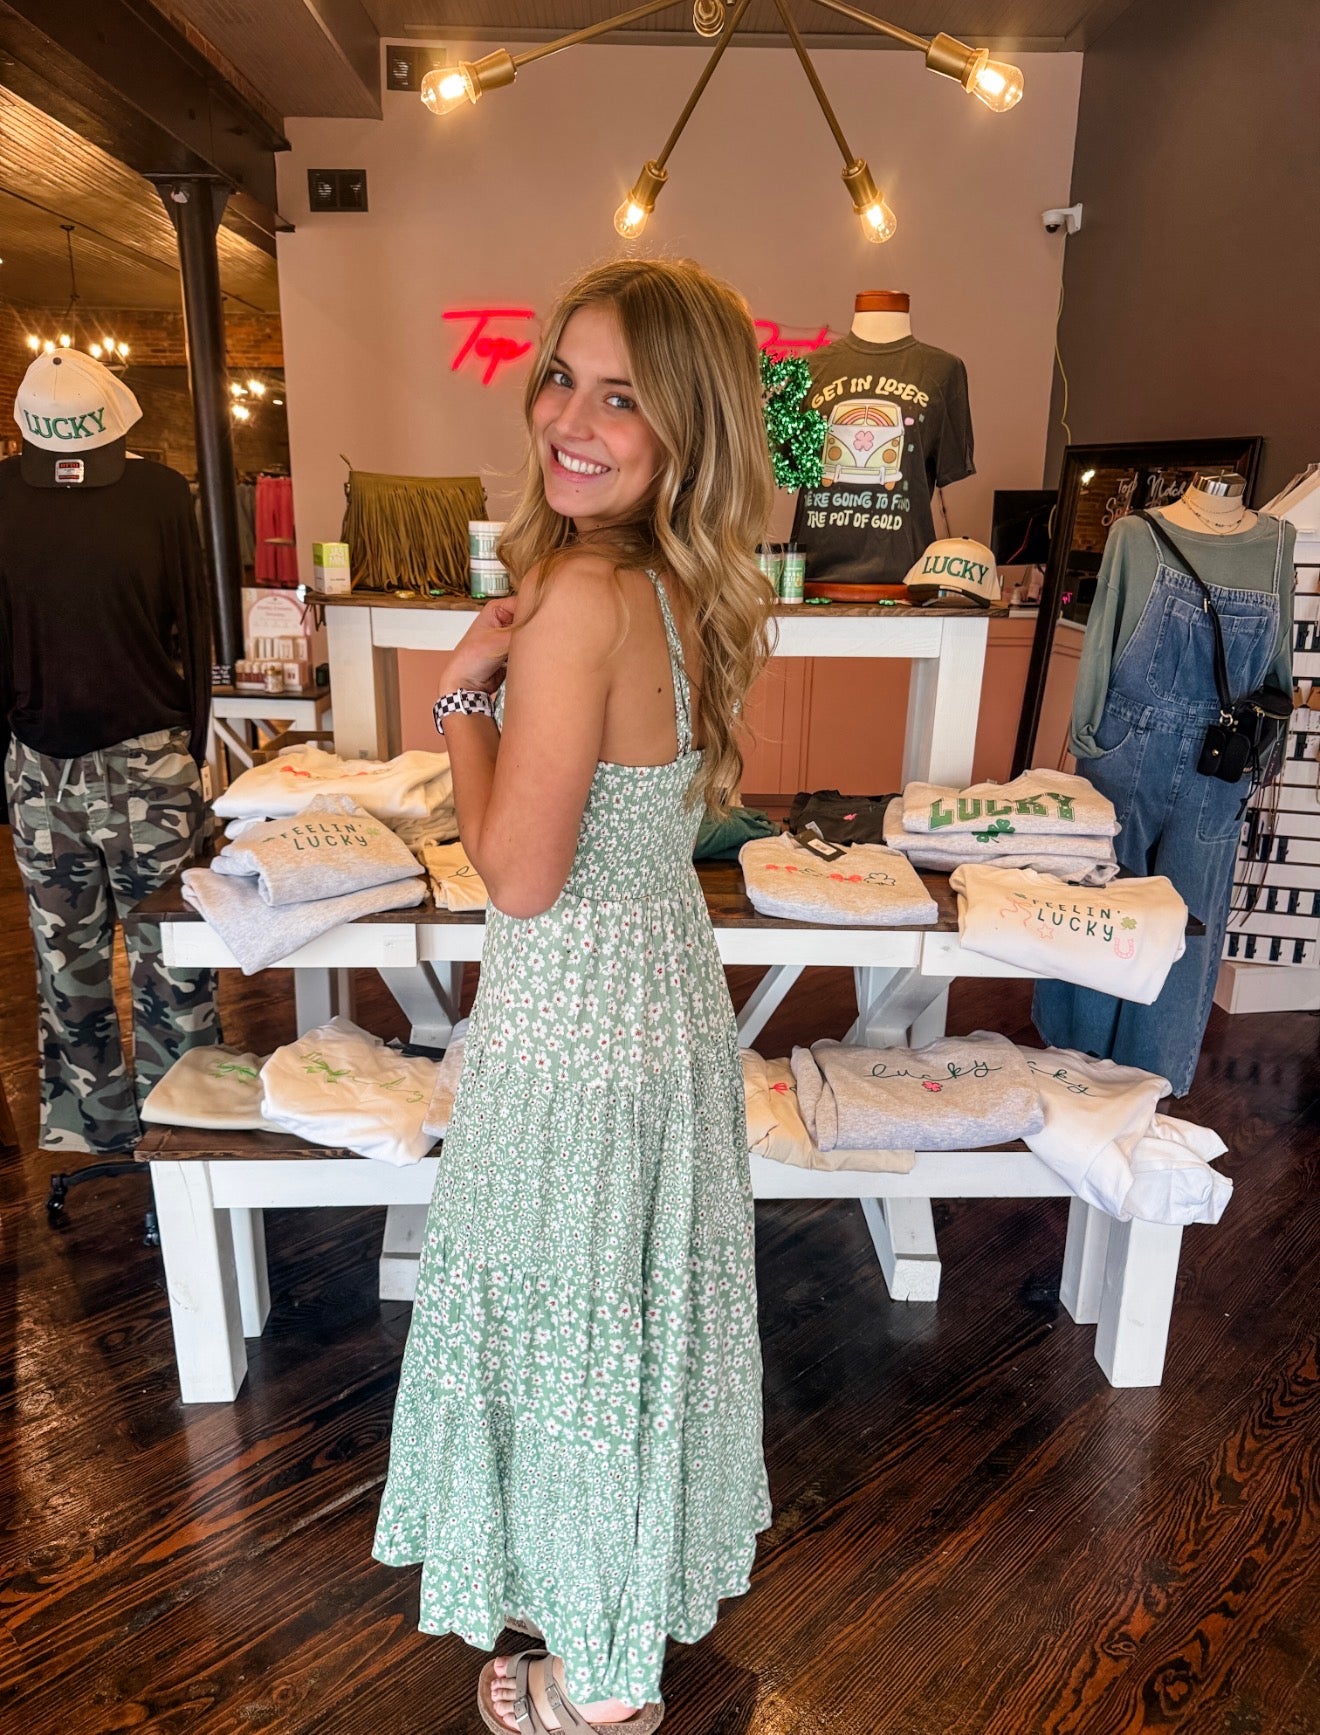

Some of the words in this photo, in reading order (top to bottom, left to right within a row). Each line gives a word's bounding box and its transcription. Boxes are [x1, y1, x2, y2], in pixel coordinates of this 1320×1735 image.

[442, 309, 535, 385] Top
[811, 376, 848, 408] GET
[850, 375, 873, 393] IN
[875, 376, 929, 408] LOSER
[24, 407, 106, 439] LUCKY
[804, 490, 831, 508] E'RE
[832, 491, 873, 509] GOING
[875, 493, 889, 509] TO
[807, 510, 828, 528] THE
[829, 509, 853, 527] POT
[853, 512, 870, 529] OF
[871, 514, 903, 531] GOLD
[922, 555, 989, 585] LUCKY
[928, 792, 1076, 832] LUCKY
